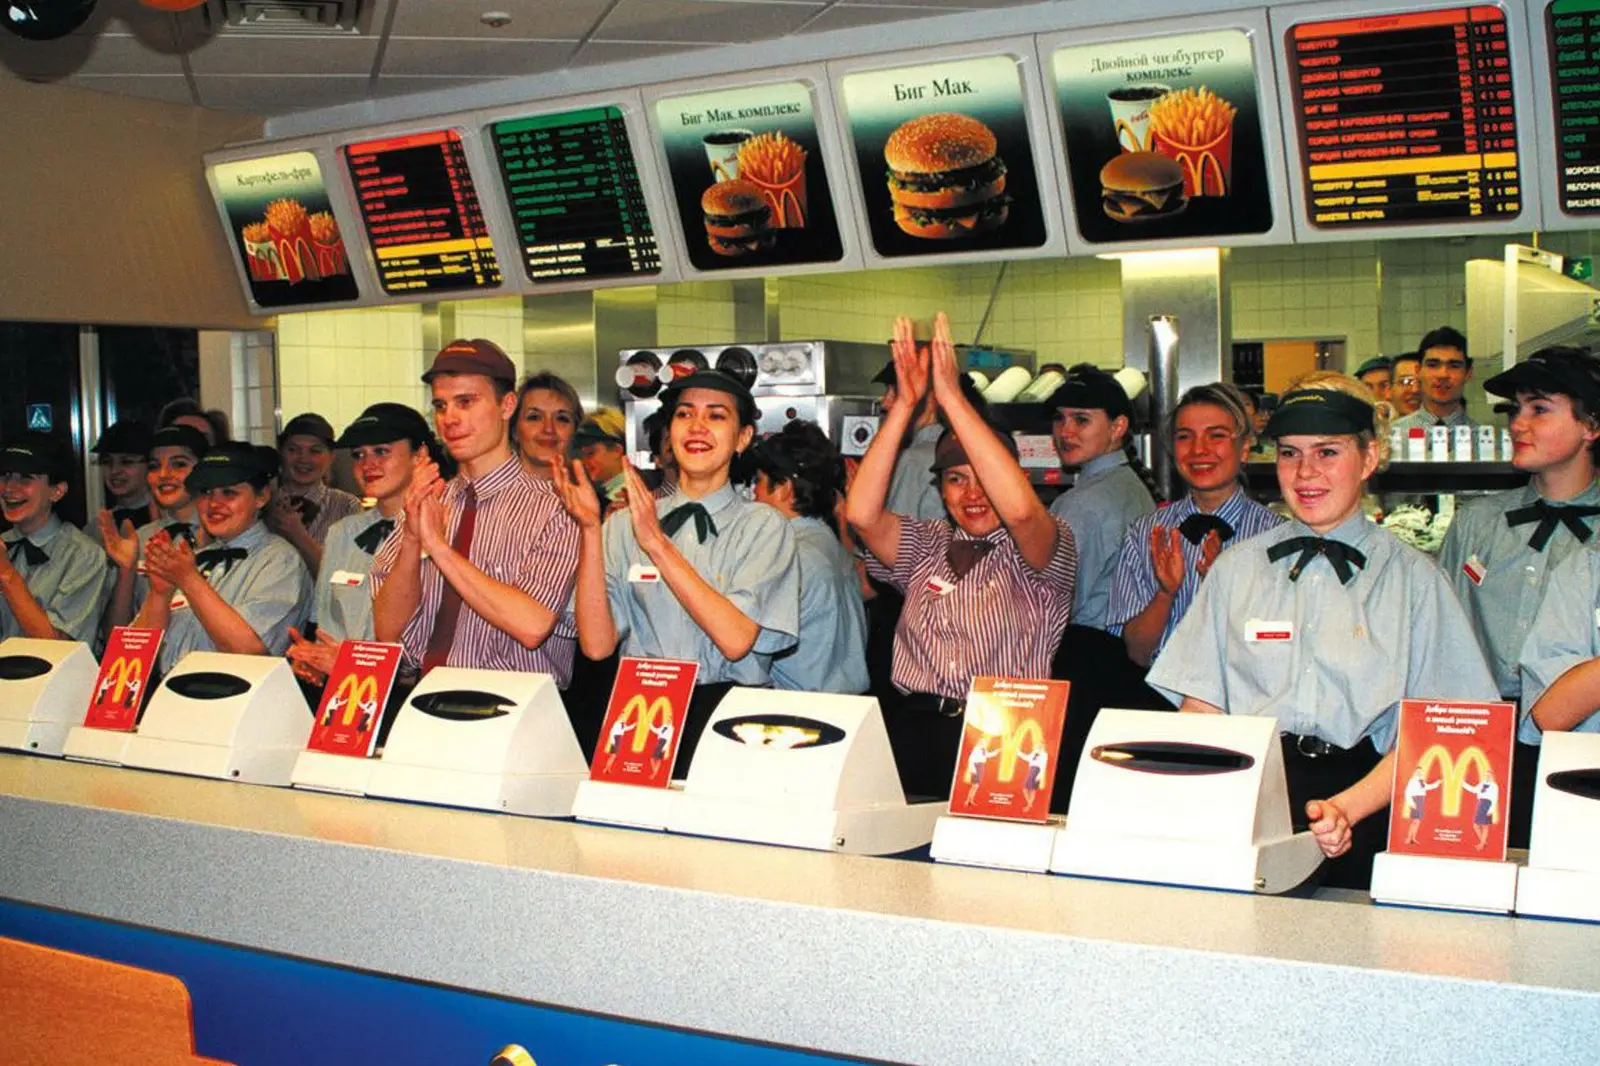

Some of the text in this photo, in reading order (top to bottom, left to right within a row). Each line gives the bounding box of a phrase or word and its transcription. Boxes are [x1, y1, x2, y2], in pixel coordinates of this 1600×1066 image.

[1091, 49, 1225, 73] Двойной чизбургер
[1126, 67, 1193, 82] комплекс
[894, 83, 926, 101] Биг
[680, 112, 702, 126] Биг
[738, 102, 801, 119] комплекс
[236, 166, 312, 188] Картофель-фри
